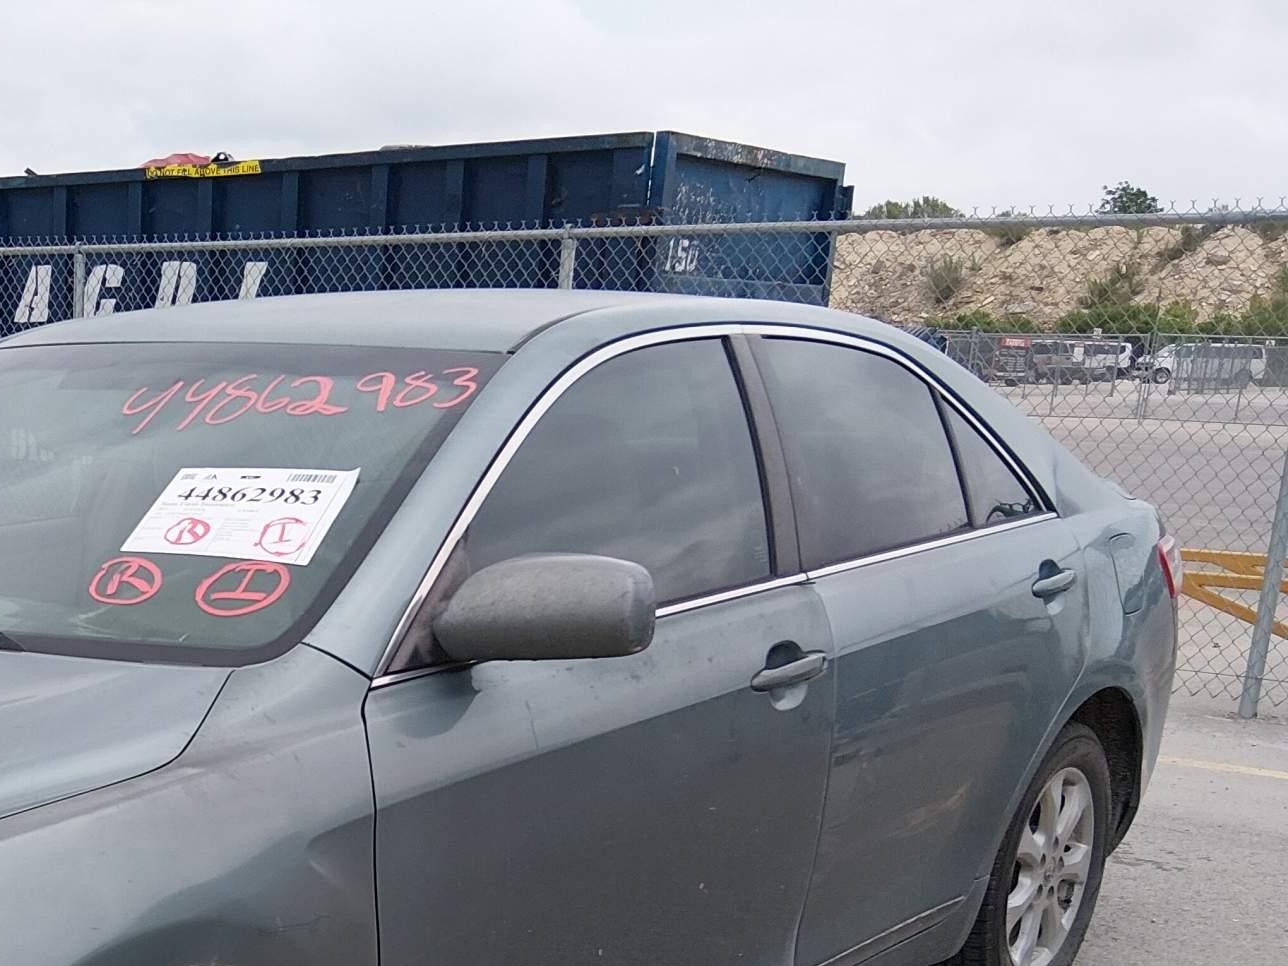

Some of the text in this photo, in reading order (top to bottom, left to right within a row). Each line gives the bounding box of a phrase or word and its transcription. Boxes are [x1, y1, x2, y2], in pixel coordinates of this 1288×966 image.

[194, 166, 221, 177] ABOVE
[242, 163, 260, 173] LINE
[178, 486, 323, 505] 44862983
